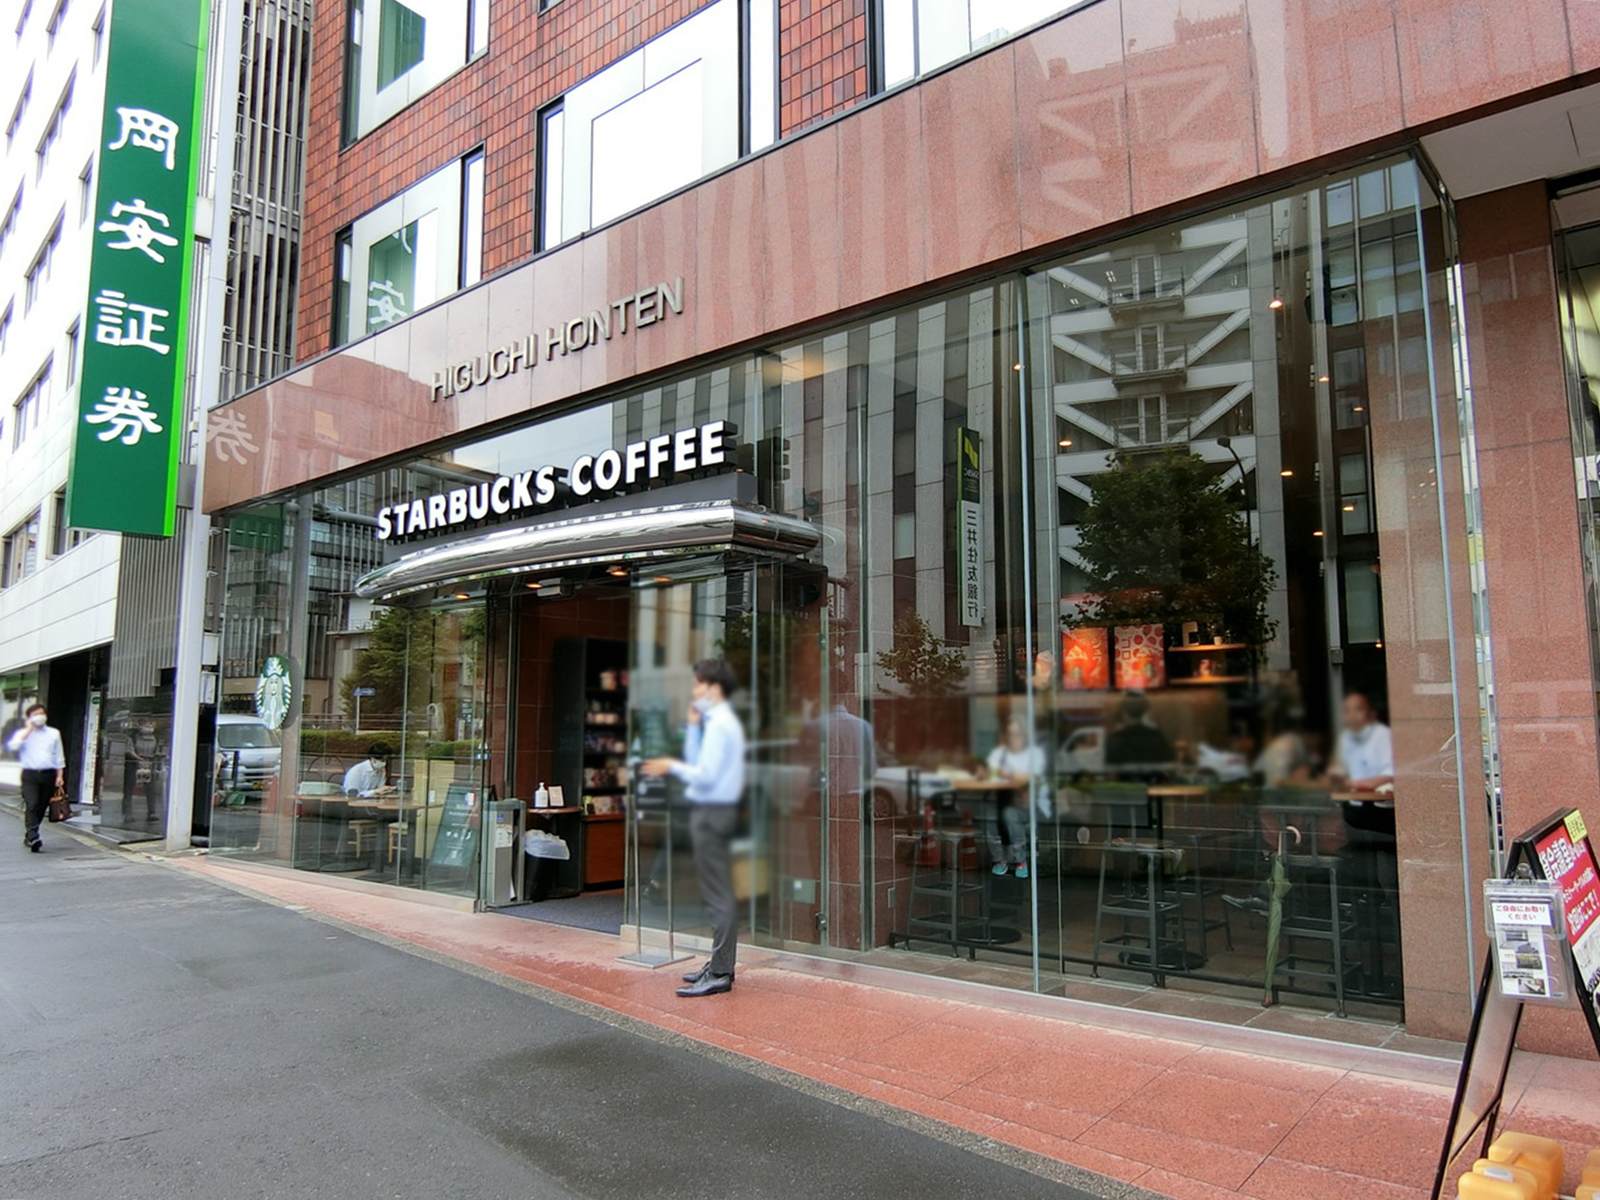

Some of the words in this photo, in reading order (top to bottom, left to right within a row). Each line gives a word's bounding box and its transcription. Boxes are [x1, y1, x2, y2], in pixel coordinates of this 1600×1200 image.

[84, 106, 179, 445] 岡安証券
[430, 332, 539, 402] HIGUCHI
[545, 276, 684, 361] HONTEN
[377, 465, 557, 540] STARBUCKS
[571, 419, 727, 496] COFFEE
[1507, 913, 1537, 921] ください
